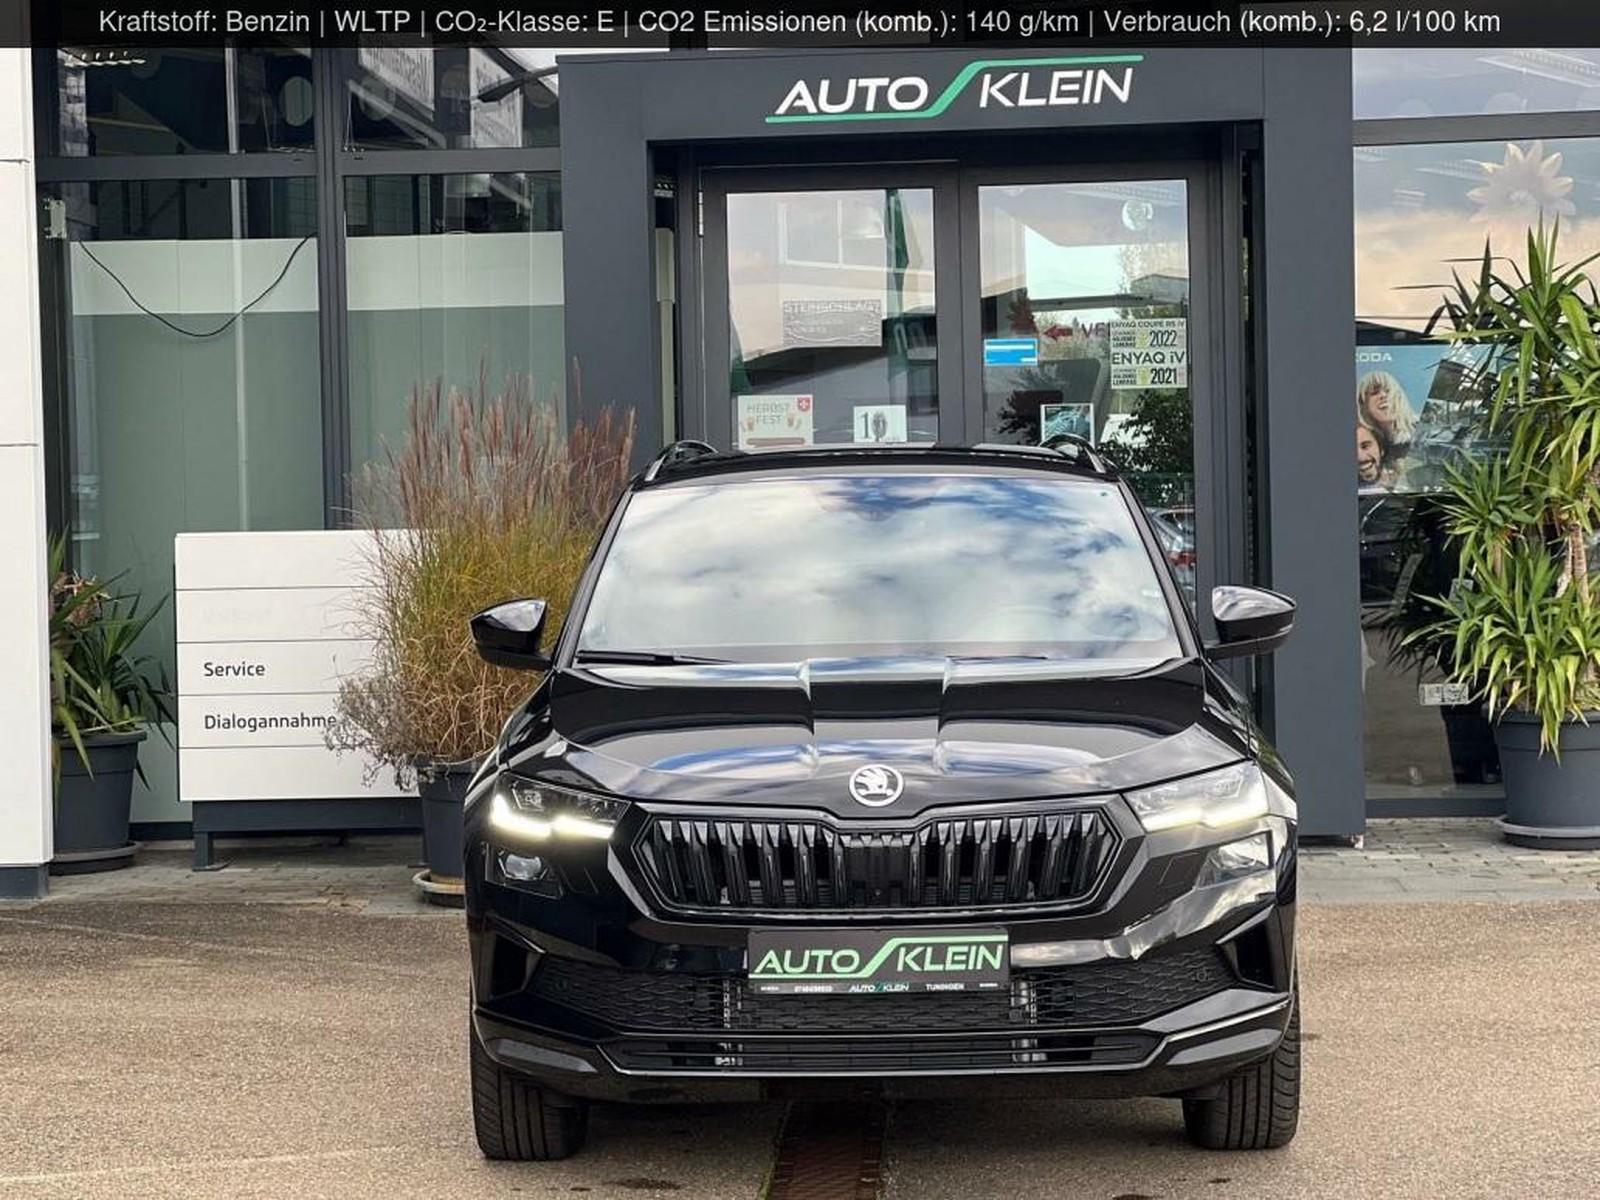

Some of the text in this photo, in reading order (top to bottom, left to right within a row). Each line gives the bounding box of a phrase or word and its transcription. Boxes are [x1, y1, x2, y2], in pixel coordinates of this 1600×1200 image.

[774, 68, 1133, 114] AUTO KLEIN
[1149, 330, 1178, 347] 2022
[1111, 351, 1185, 365] ENYAQ iV
[1150, 367, 1177, 385] 2021
[756, 414, 783, 425] FEST
[204, 661, 266, 677] Service
[204, 713, 337, 732] Dialogannahme
[753, 944, 1003, 974] AUTO KLEIN
